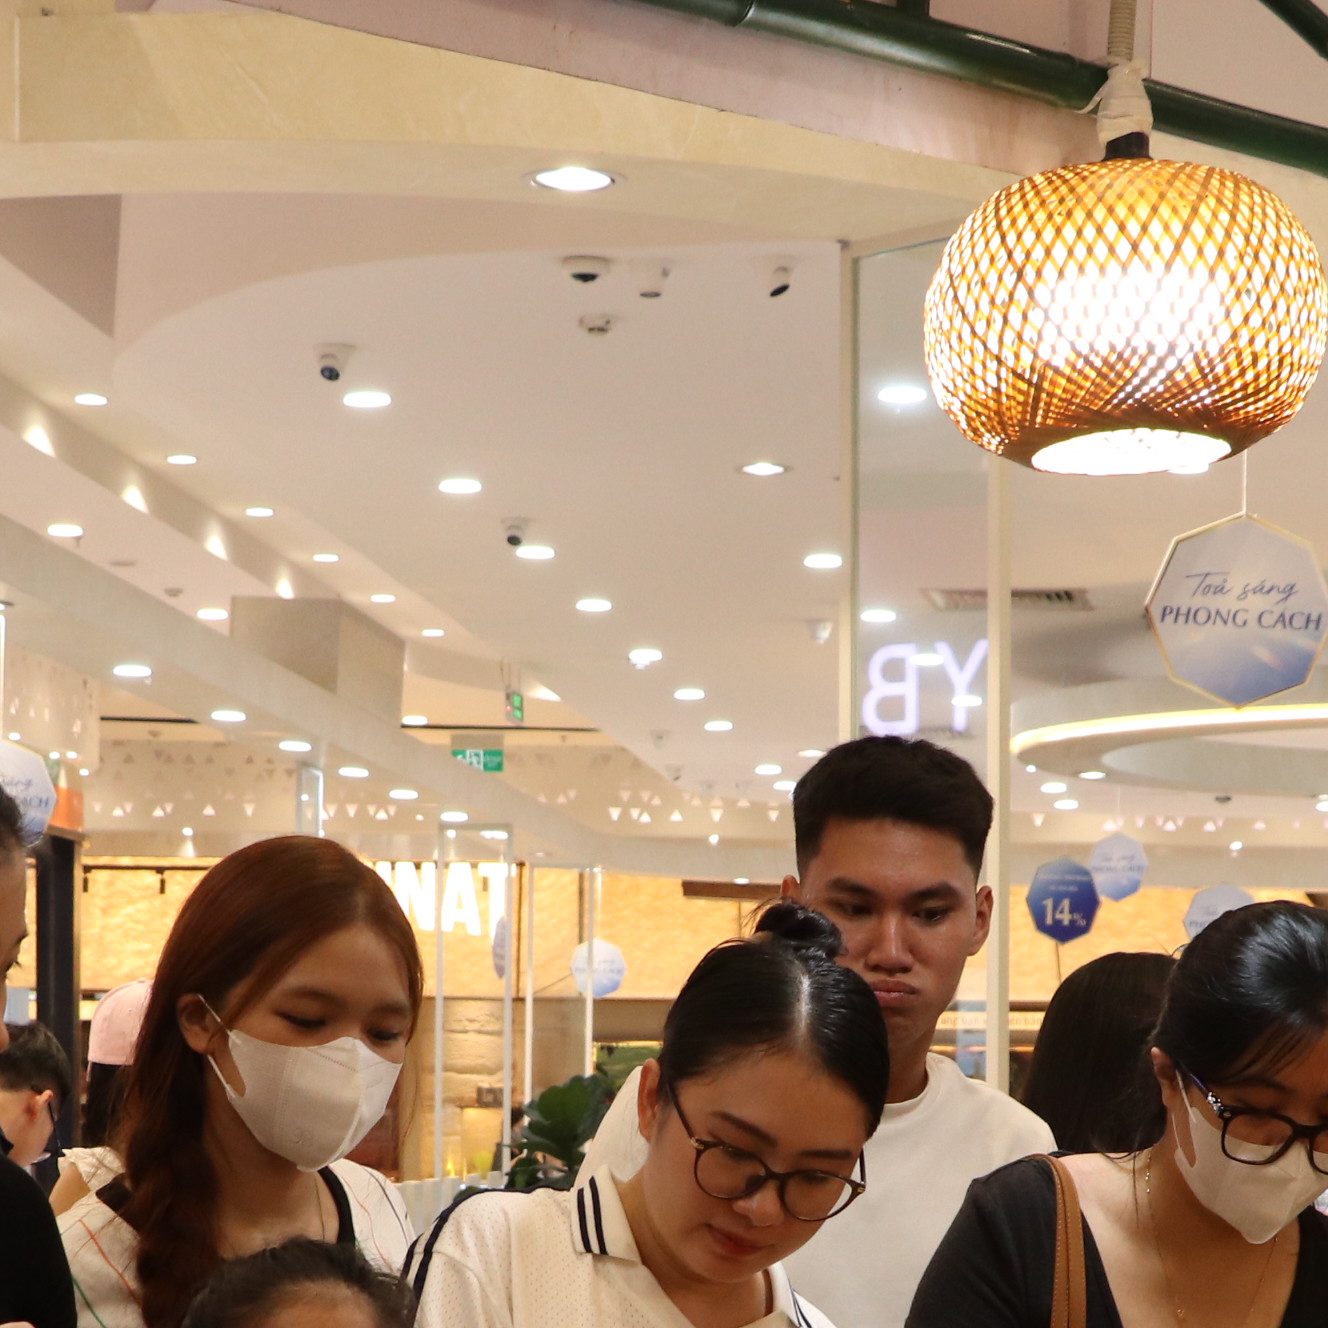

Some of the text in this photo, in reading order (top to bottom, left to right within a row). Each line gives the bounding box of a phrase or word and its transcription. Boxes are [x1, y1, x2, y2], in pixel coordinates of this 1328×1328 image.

[1236, 580, 1299, 605] sáng
[1160, 605, 1323, 630] PHONG CÁCH
[1042, 898, 1087, 926] 14%
